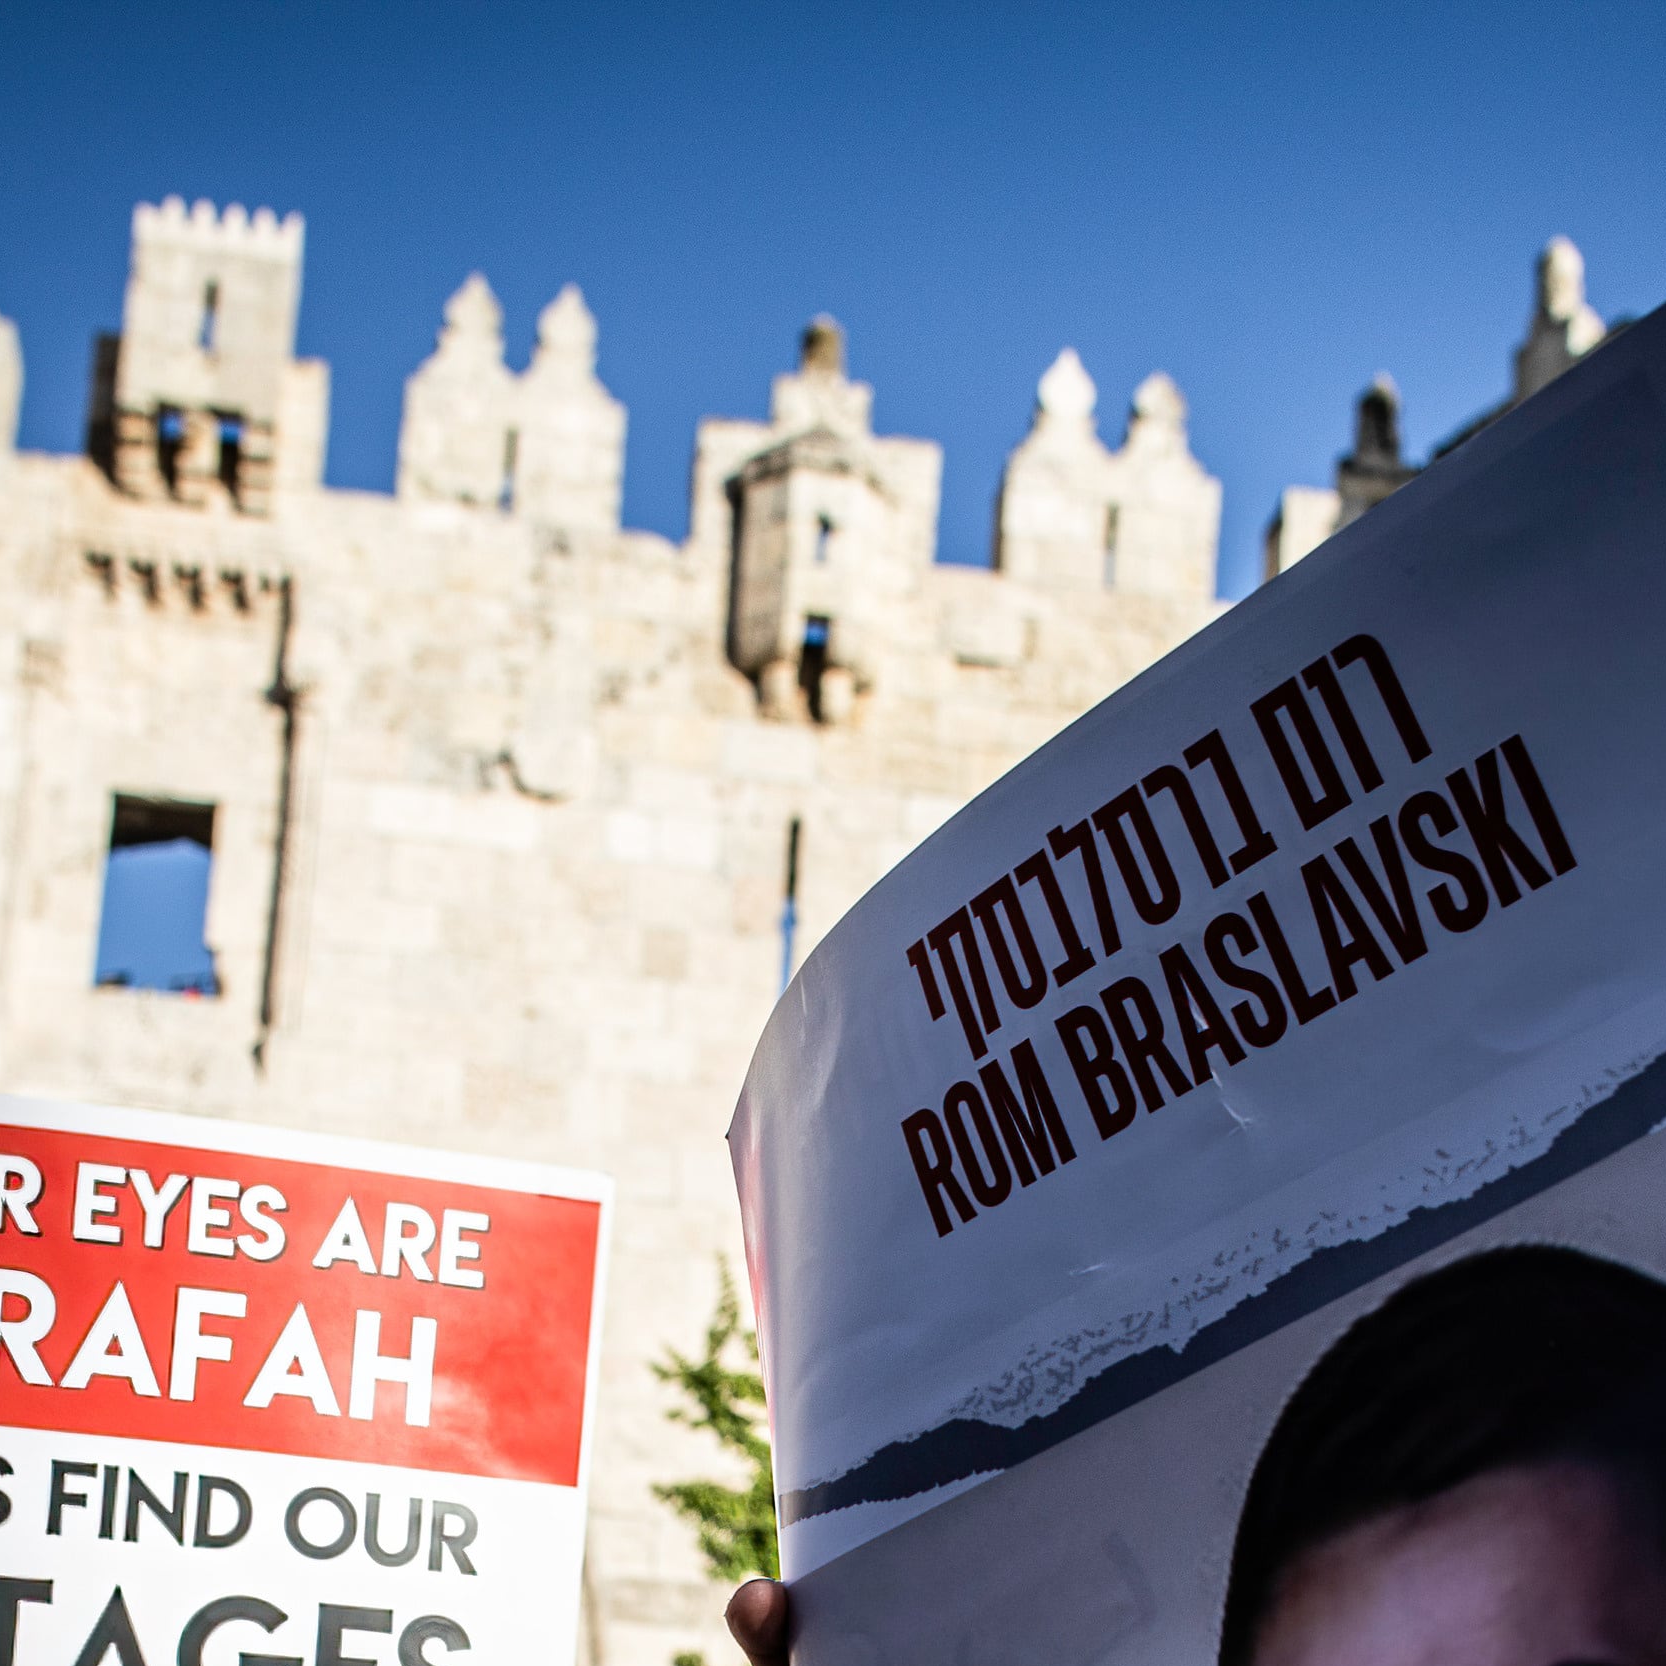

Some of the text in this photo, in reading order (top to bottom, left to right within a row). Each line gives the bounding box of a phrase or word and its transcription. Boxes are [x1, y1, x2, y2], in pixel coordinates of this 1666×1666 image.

[901, 733, 1578, 1238] ROM BRASLAVSKI
[906, 633, 1431, 1061] רום ברסלבסקי
[71, 1161, 288, 1262] EYES
[312, 1198, 491, 1290] ARE
[46, 1459, 252, 1549] FIND
[285, 1487, 479, 1577] OUR
